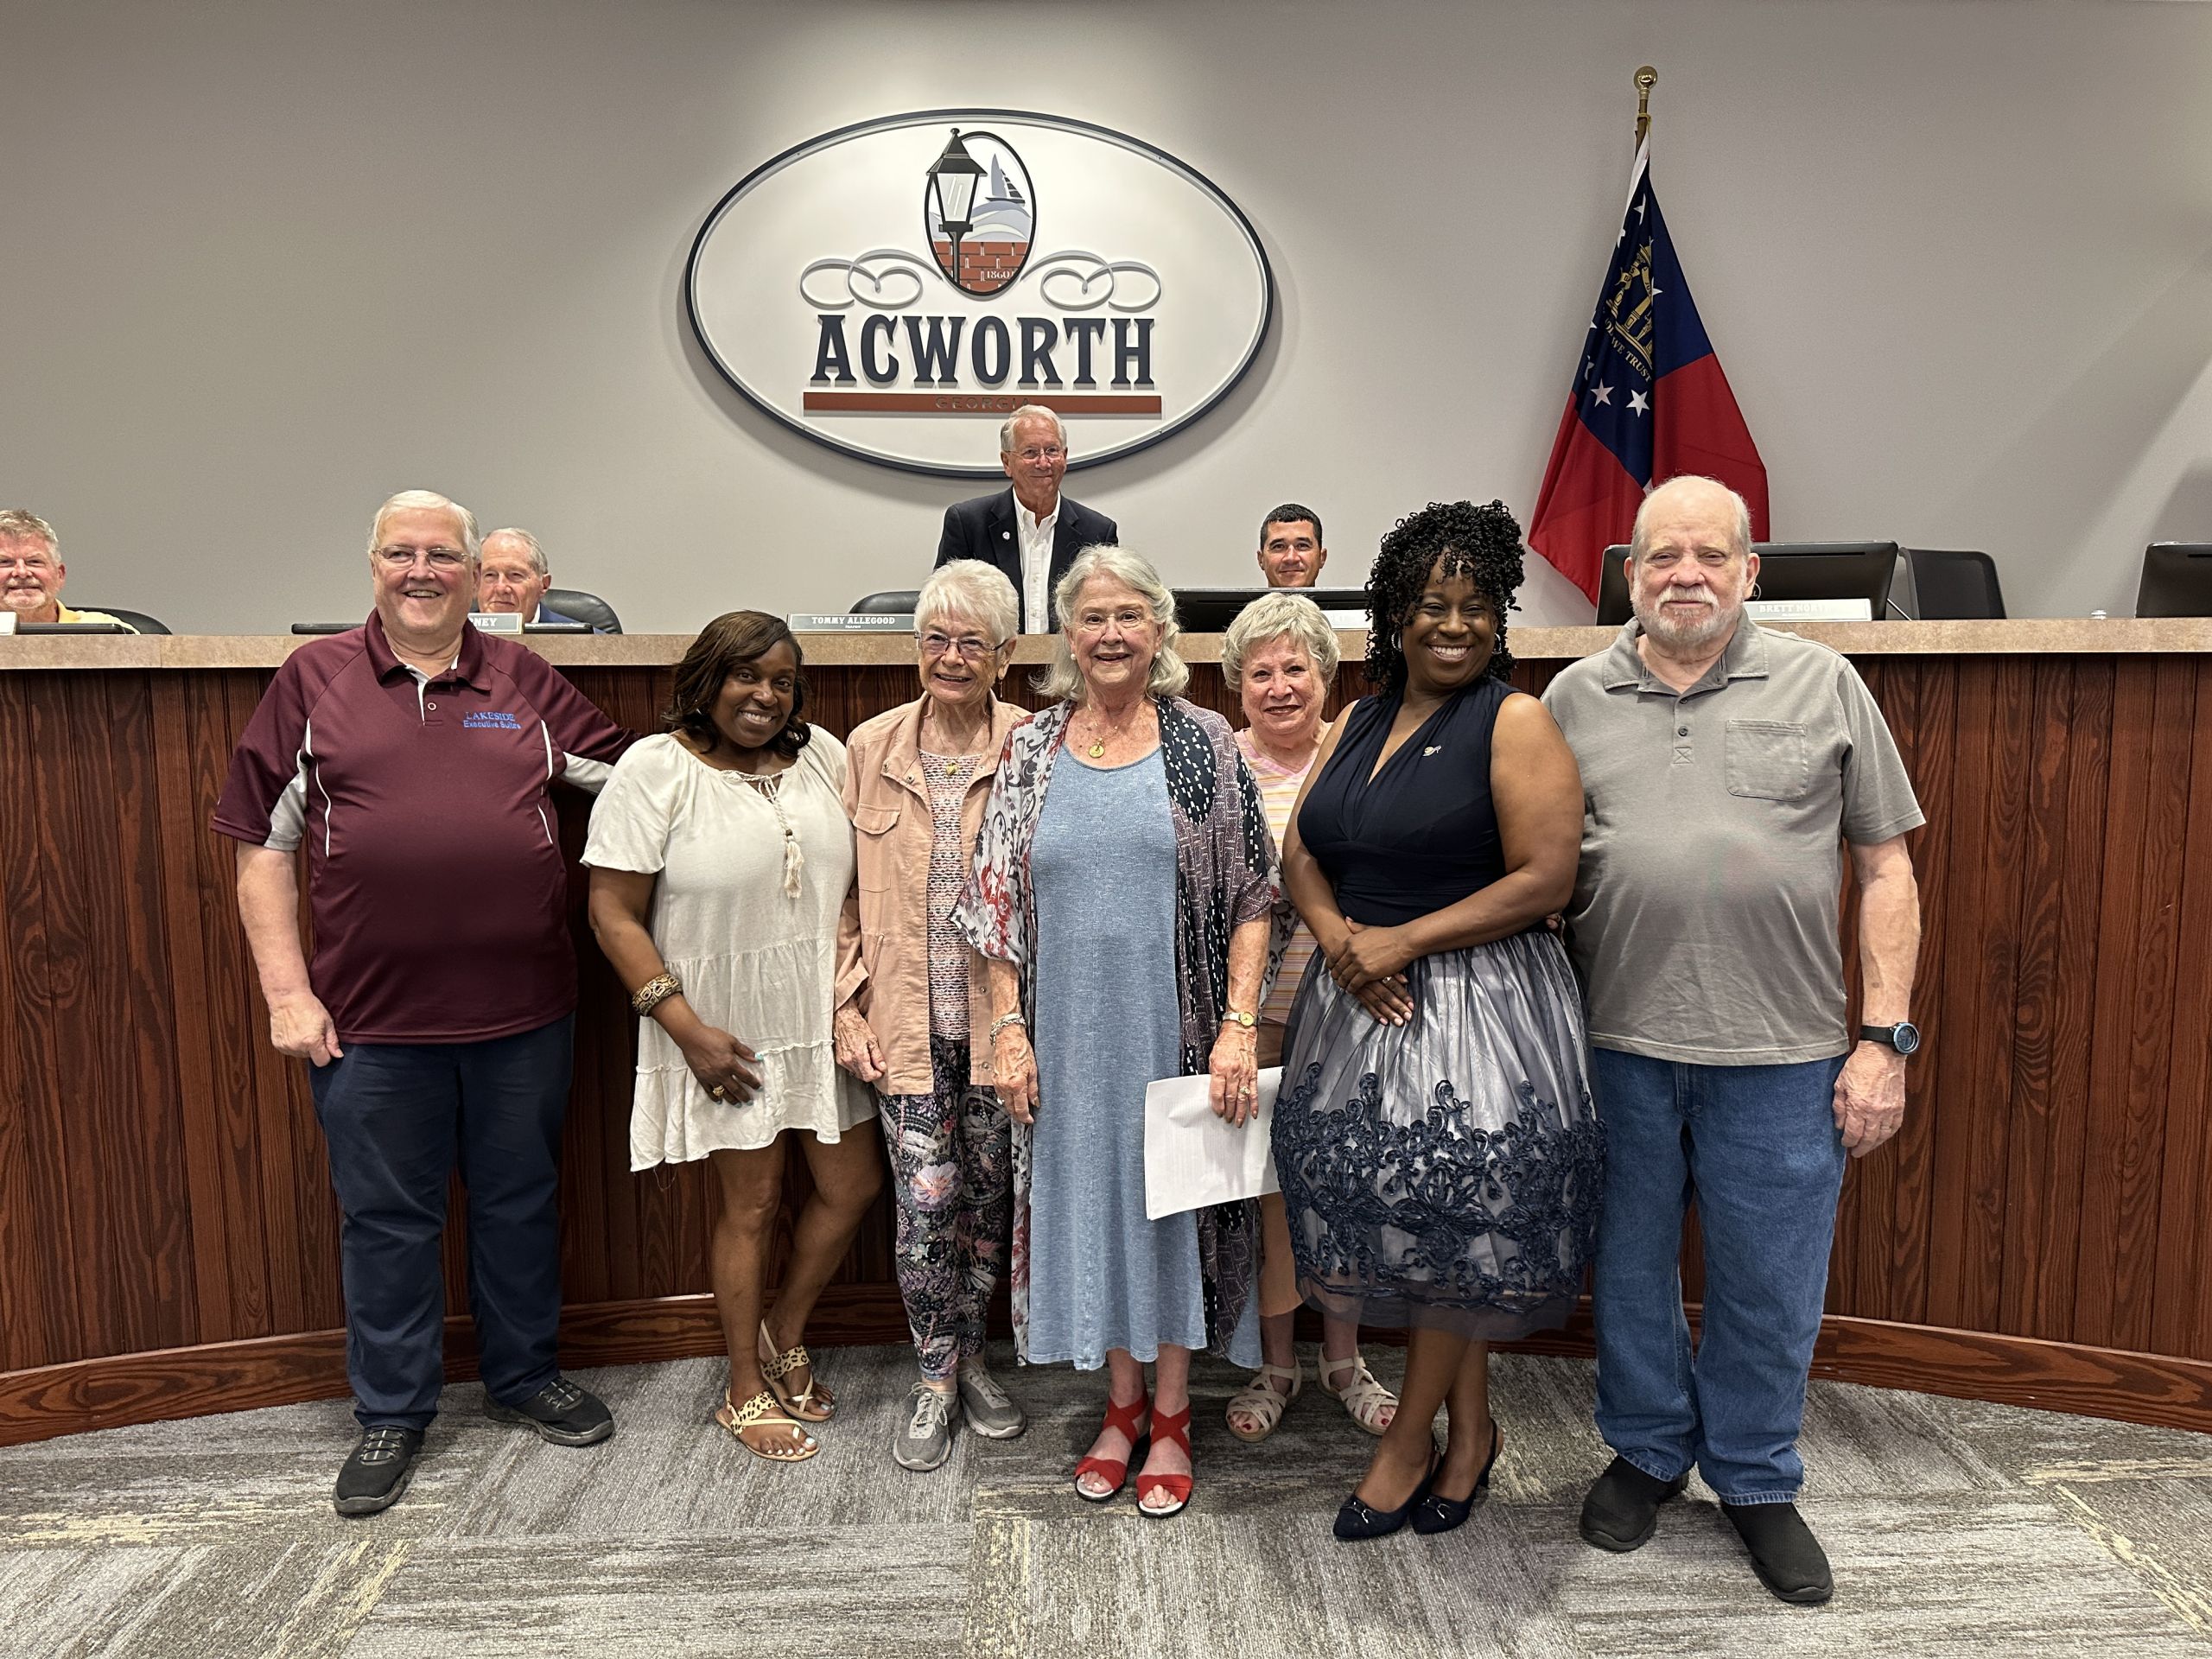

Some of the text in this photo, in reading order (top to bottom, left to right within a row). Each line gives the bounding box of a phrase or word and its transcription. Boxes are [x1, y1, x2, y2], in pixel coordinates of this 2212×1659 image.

[987, 270, 1010, 279] 1860
[810, 314, 1154, 385] ACWORTH
[1611, 337, 1652, 382] WE TRUST
[1759, 605, 1795, 613] BRETT
[811, 616, 895, 625] TOMMY ALLEGOOD
[466, 711, 516, 721] LAKESIDE
[463, 720, 499, 728] Executive
